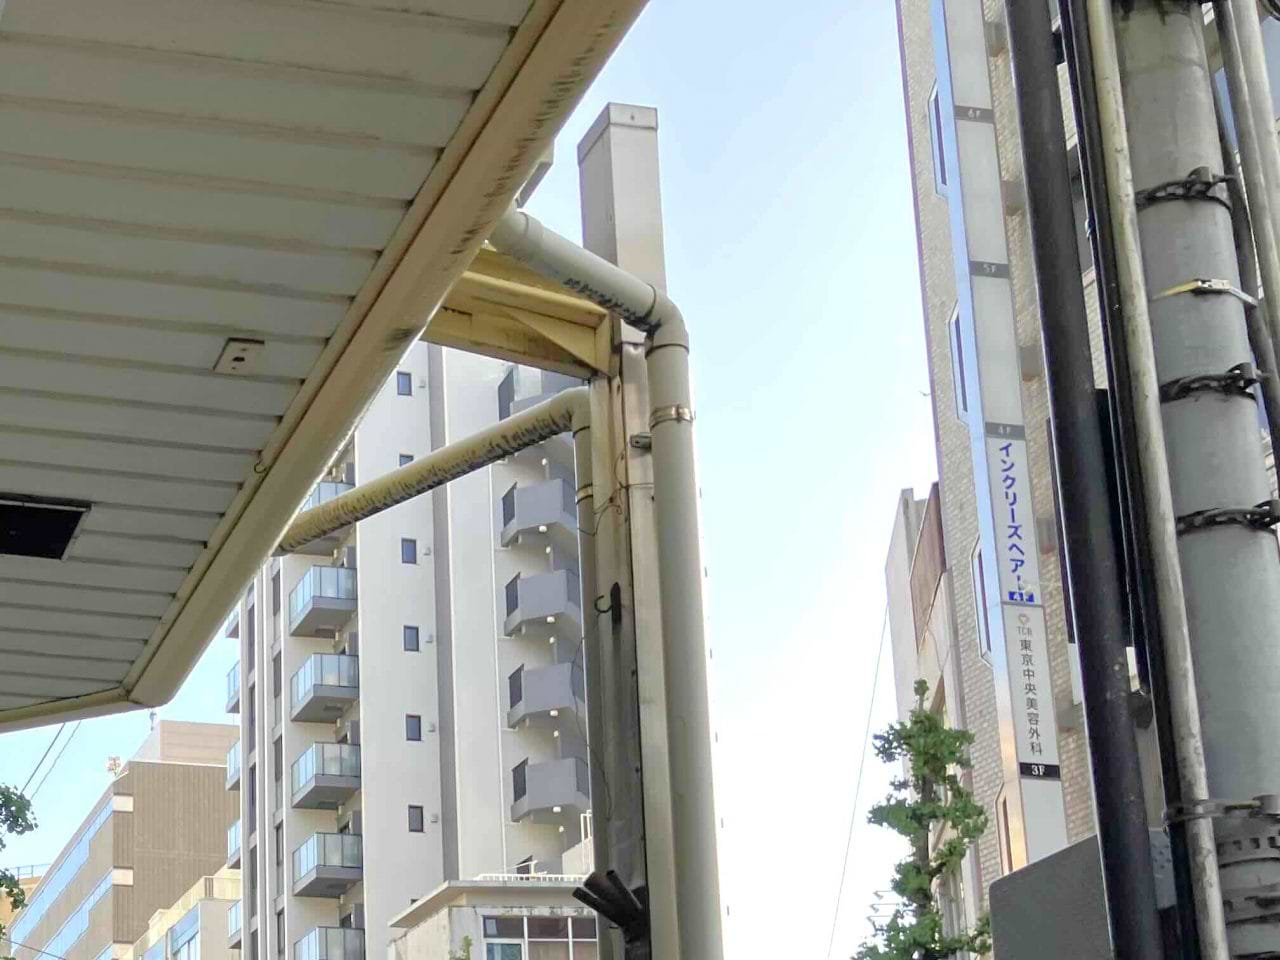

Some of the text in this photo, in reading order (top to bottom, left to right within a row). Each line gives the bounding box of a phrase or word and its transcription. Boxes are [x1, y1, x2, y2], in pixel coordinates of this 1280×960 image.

[1020, 639, 1043, 756] 東京中央美容外科
[1031, 765, 1045, 776] 3F
